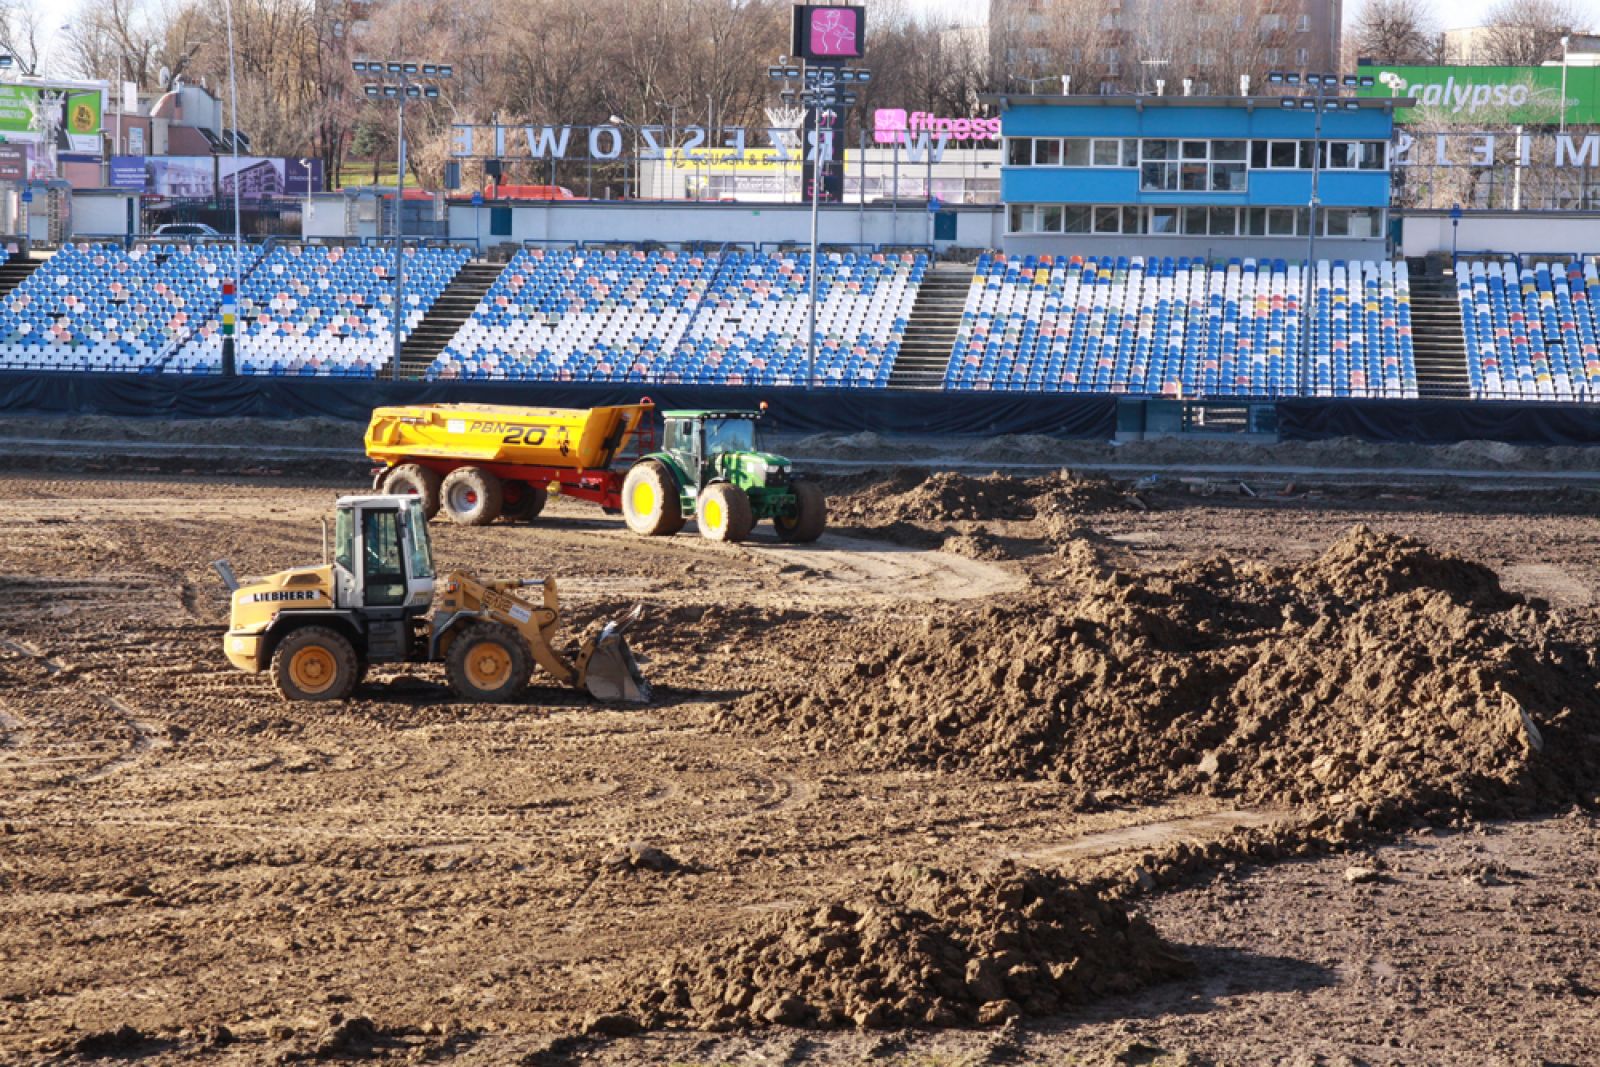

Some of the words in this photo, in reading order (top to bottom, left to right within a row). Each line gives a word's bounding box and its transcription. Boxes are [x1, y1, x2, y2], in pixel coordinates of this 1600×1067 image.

[1407, 76, 1530, 113] calypso
[908, 111, 1001, 140] fitness
[253, 590, 315, 602] LIEBHERR
